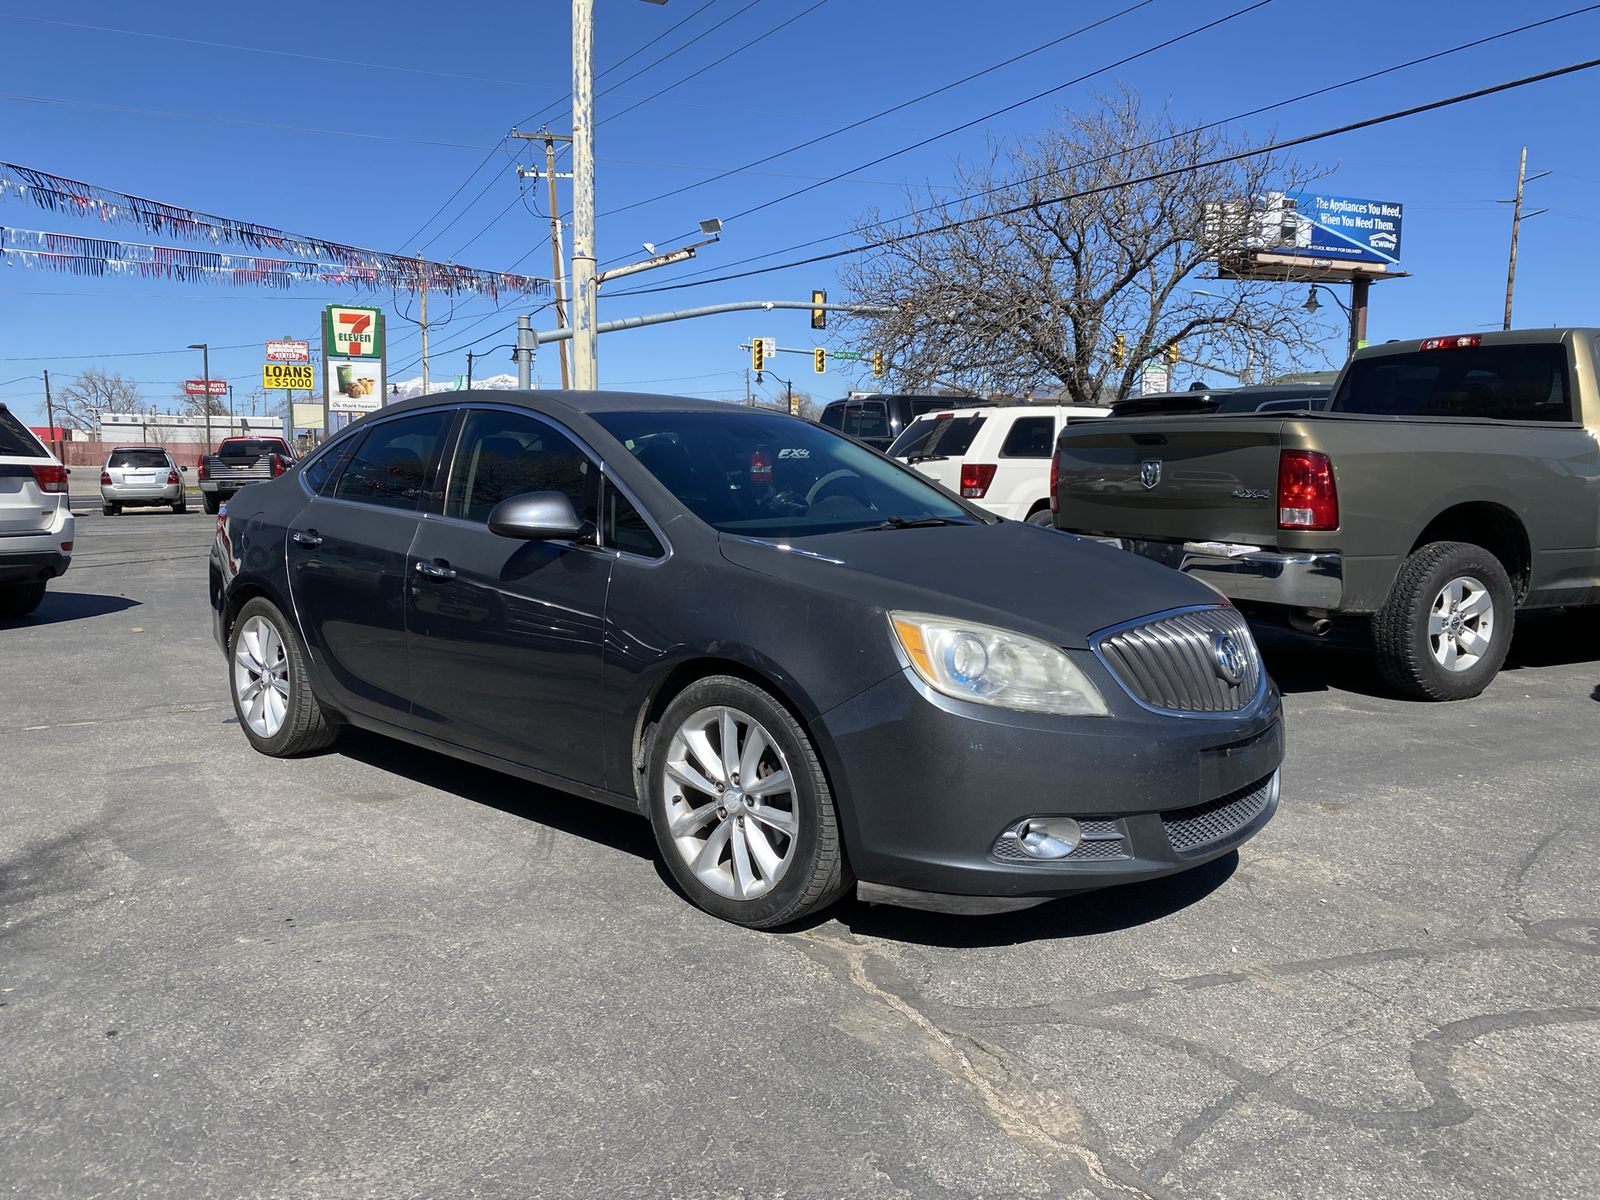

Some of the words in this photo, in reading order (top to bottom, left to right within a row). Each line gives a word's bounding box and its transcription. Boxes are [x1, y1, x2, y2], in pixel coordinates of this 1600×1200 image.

[1316, 197, 1329, 209] The
[1329, 199, 1367, 213] Appliances
[1367, 203, 1381, 215] You
[1381, 205, 1401, 218] Need,
[1321, 213, 1341, 225] When
[1341, 215, 1355, 227] You
[1355, 217, 1373, 229] Need
[1374, 218, 1395, 231] Them.
[339, 313, 371, 355] 7
[265, 366, 312, 378] LOANS
